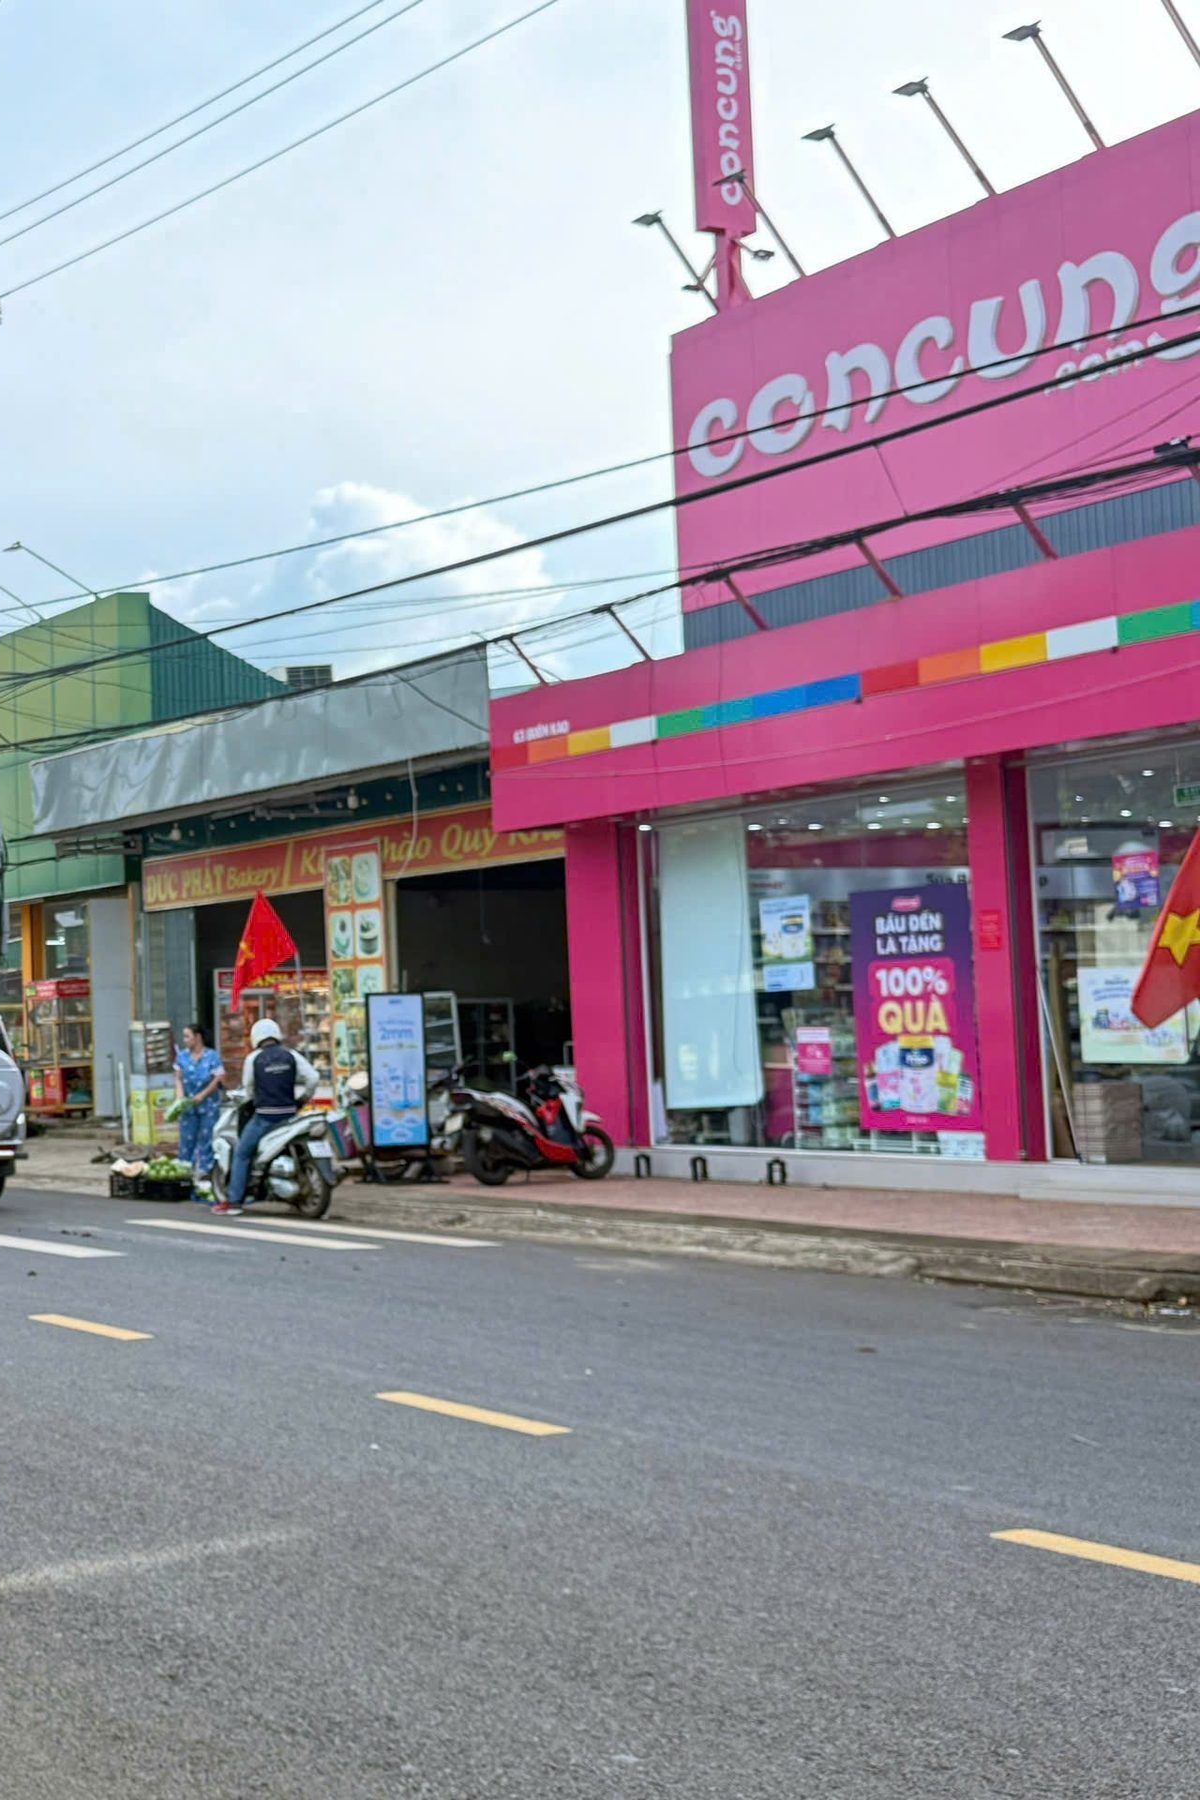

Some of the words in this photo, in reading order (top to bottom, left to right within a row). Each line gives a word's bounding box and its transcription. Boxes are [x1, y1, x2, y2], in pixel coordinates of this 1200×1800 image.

[710, 9, 743, 206] concung
[687, 210, 1200, 478] concung
[181, 857, 225, 898] PHÁT
[227, 864, 280, 890] Bakery
[876, 935, 898, 955] LÀ
[875, 965, 949, 997] 100%
[878, 995, 949, 1035] QUÀ
